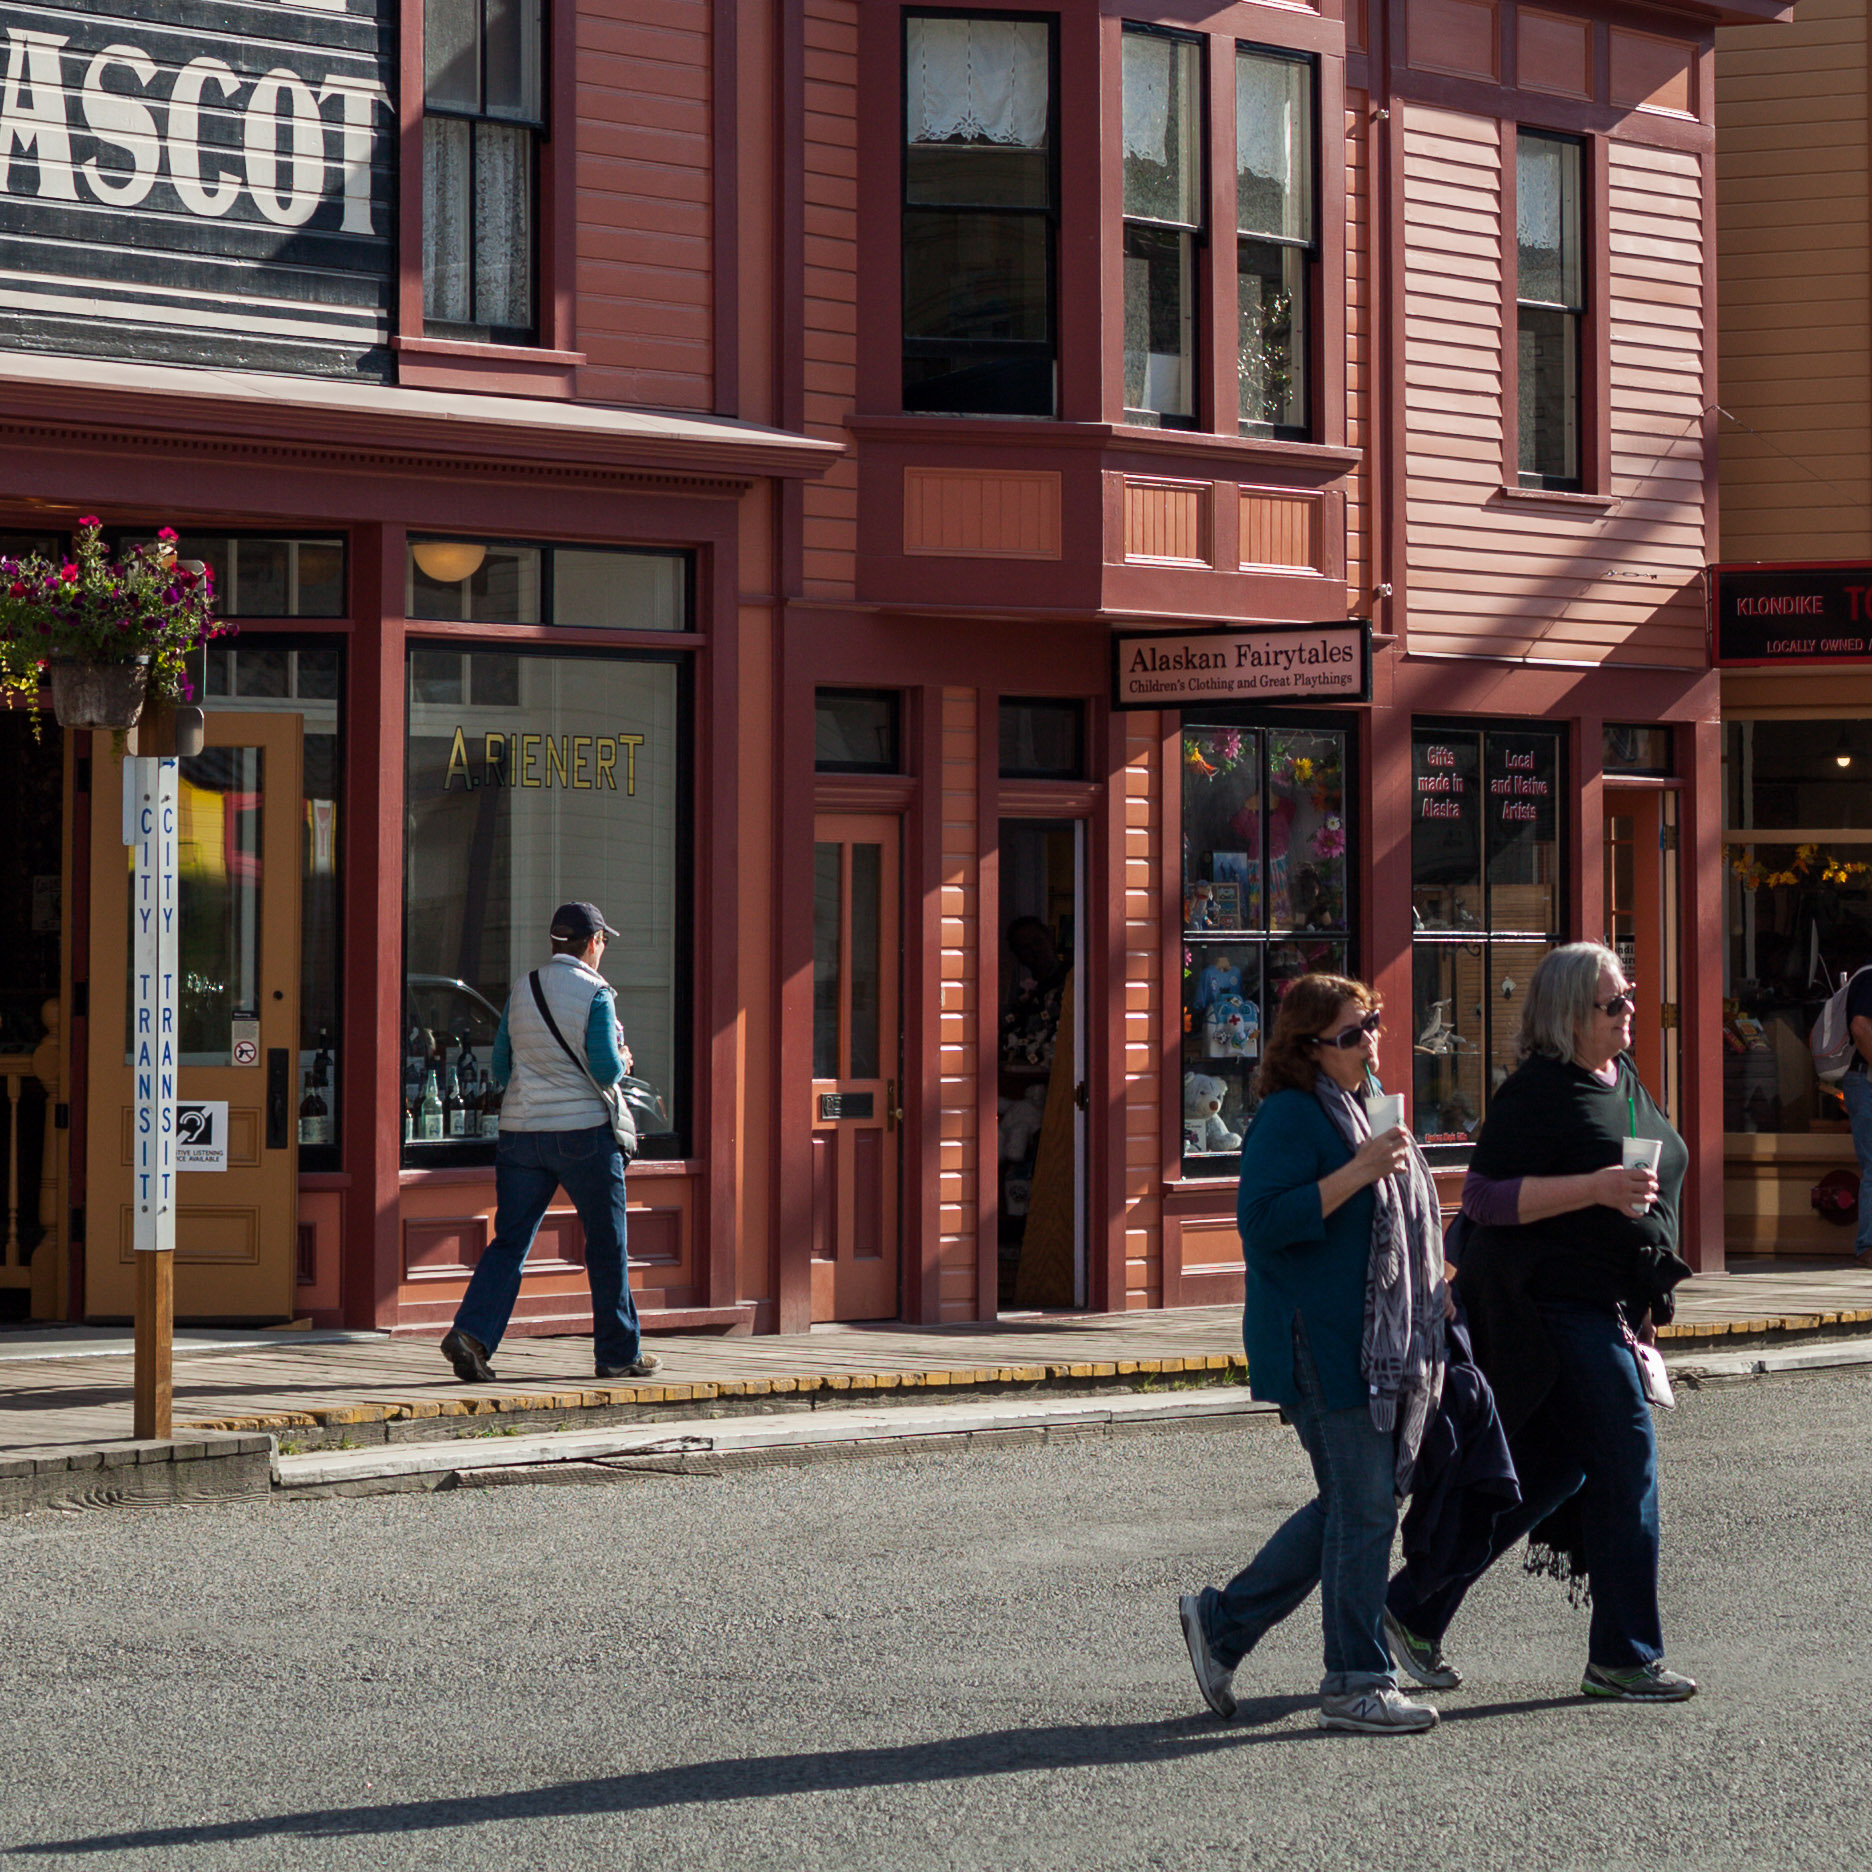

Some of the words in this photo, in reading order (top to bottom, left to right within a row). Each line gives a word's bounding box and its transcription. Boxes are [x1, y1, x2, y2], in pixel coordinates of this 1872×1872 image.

[1737, 595, 1824, 616] KLONDIKE
[1129, 646, 1226, 673] Alaskan
[1234, 640, 1353, 670] Fairytales
[1767, 639, 1816, 654] LOCALLY
[1820, 638, 1863, 652] OWNED
[1129, 678, 1185, 694] Children's
[1188, 676, 1234, 693] Clothing
[1237, 675, 1257, 689] and
[1260, 674, 1290, 688] Great
[1293, 672, 1353, 689] Playthings
[1428, 746, 1454, 767] Gifts
[1506, 749, 1534, 769] Local
[1418, 773, 1449, 792] made
[1453, 773, 1464, 793] in
[1491, 775, 1512, 794] and
[1514, 775, 1548, 795] Native
[1422, 798, 1461, 819] Alaska
[1502, 800, 1537, 820] Artists
[139, 808, 152, 933] CITY
[163, 808, 173, 933] CITY
[138, 974, 151, 1200] TRANSIT
[161, 974, 172, 1200] TRANSIT
